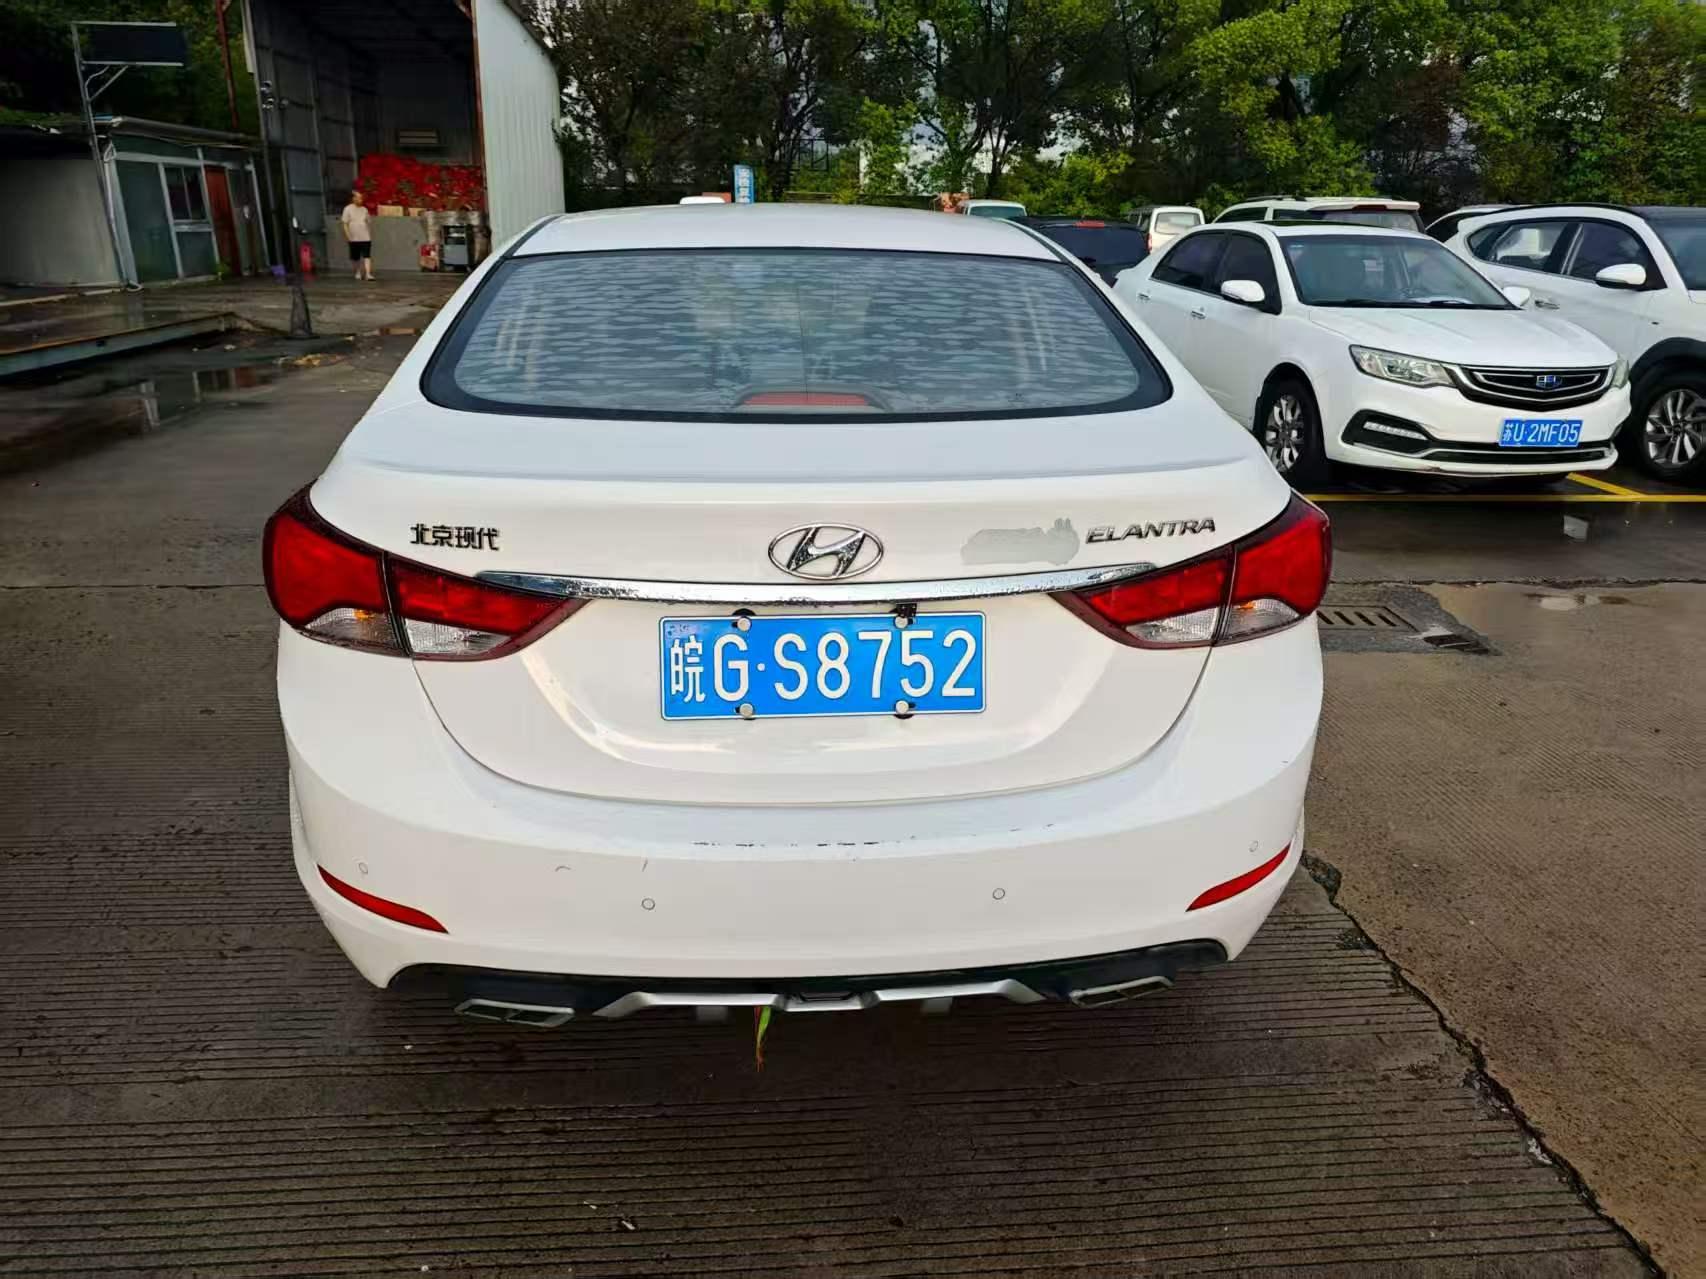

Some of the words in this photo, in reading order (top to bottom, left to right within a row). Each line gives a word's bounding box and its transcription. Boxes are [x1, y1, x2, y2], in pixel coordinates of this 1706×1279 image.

[410, 523, 499, 551] 北京现代
[1086, 518, 1216, 544] ELANTRA
[670, 629, 977, 703] 皖G·S8752
